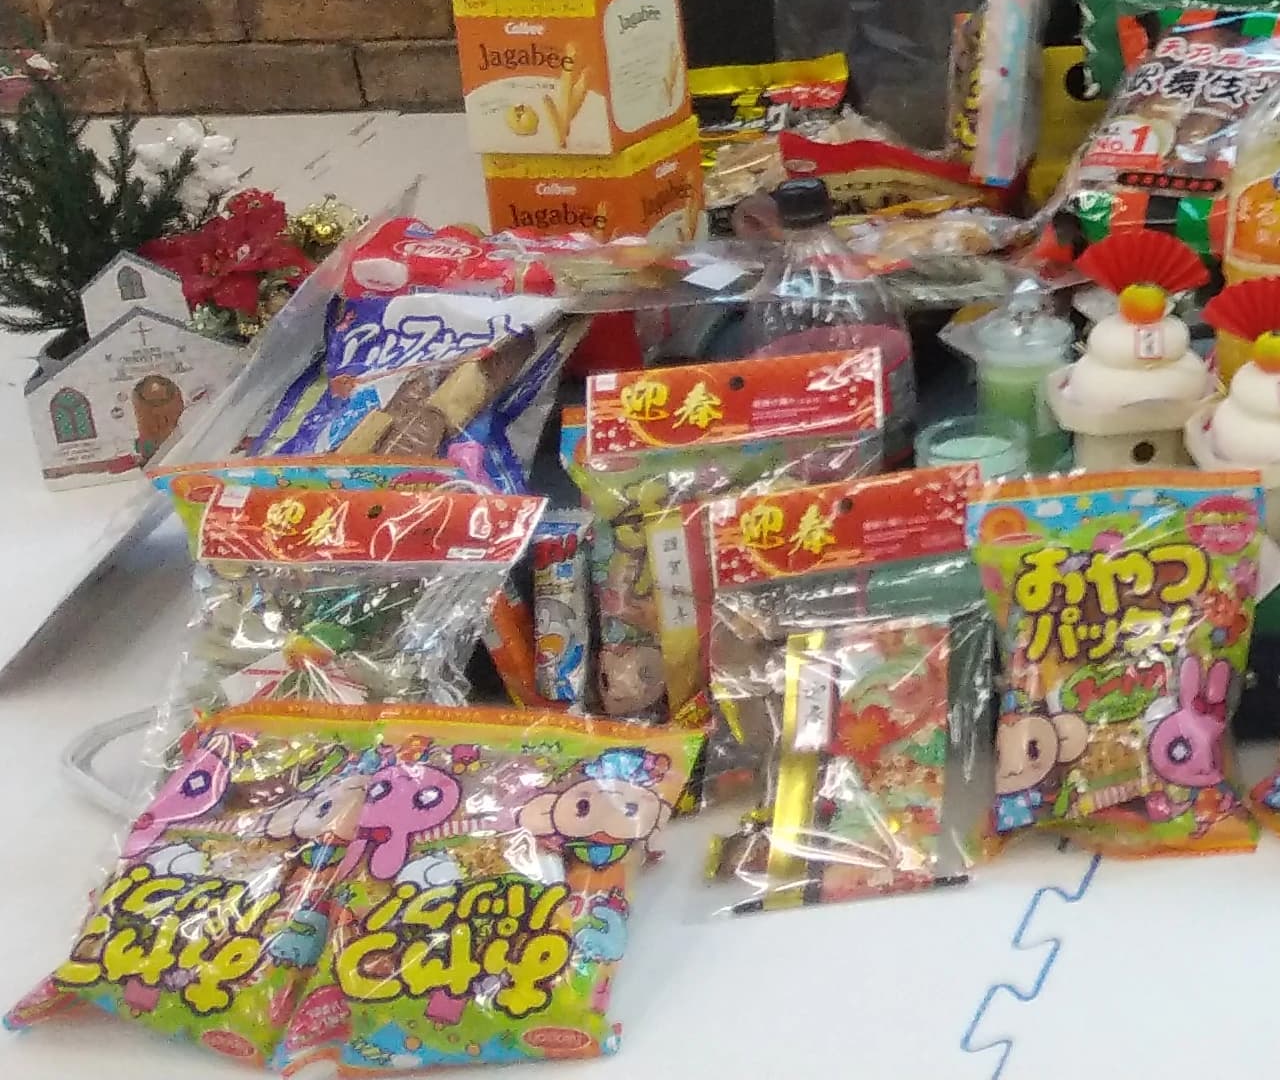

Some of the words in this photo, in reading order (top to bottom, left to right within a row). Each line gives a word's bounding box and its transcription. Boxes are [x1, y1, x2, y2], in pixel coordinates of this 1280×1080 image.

[480, 42, 575, 72] Jagabee
[508, 201, 608, 230] Jagabee
[620, 378, 724, 429] 迎春
[740, 502, 836, 558] 迎春
[1016, 547, 1210, 614] おやつ
[366, 879, 573, 936] パック!
[335, 922, 572, 1016] おやつ
